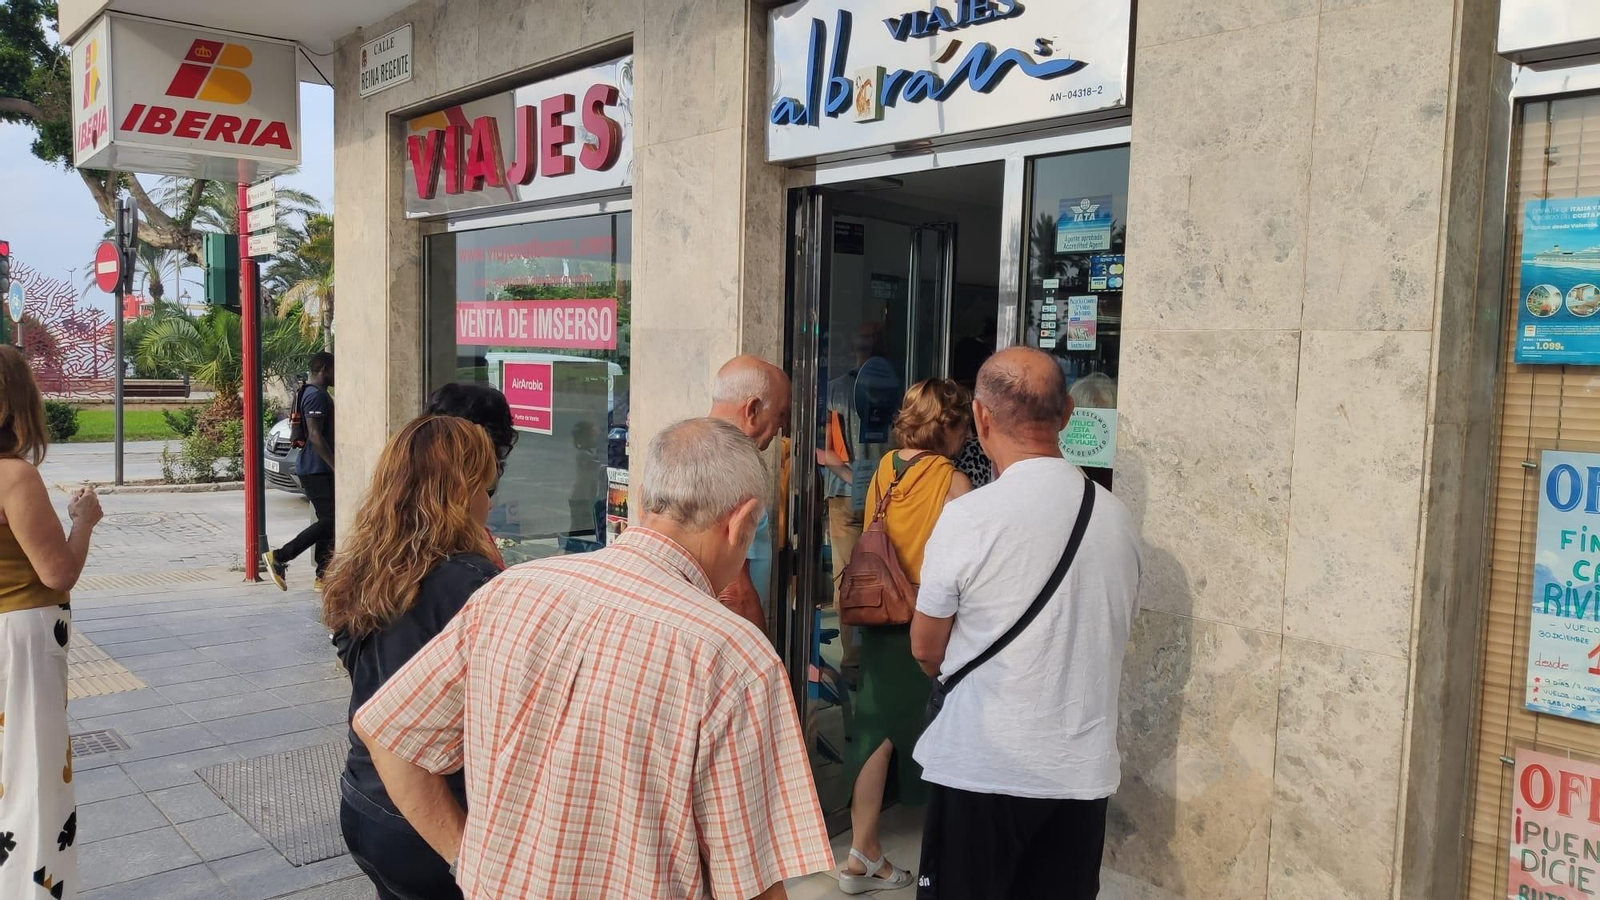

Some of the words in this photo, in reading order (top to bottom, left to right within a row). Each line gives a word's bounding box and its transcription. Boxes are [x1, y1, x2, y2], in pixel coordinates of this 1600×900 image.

[882, 0, 1026, 42] VIAJES
[373, 36, 395, 56] CALLE
[361, 67, 380, 91] REINA
[380, 54, 409, 83] REGENTE
[1049, 85, 1103, 103] AN-04318-2
[77, 105, 108, 153] IBERIA
[120, 103, 293, 150] IBERIA
[407, 83, 623, 200] VIAJES
[1073, 212, 1096, 222] IATA
[1089, 241, 1104, 249] Agent
[460, 308, 504, 338] VENTA
[508, 308, 528, 339] DE
[533, 306, 612, 342] IMSERSO
[511, 378, 543, 391] AirArabia
[1066, 432, 1097, 440] AGENCIA
[1075, 439, 1098, 447] VIAJES
[1534, 652, 1569, 670] desde
